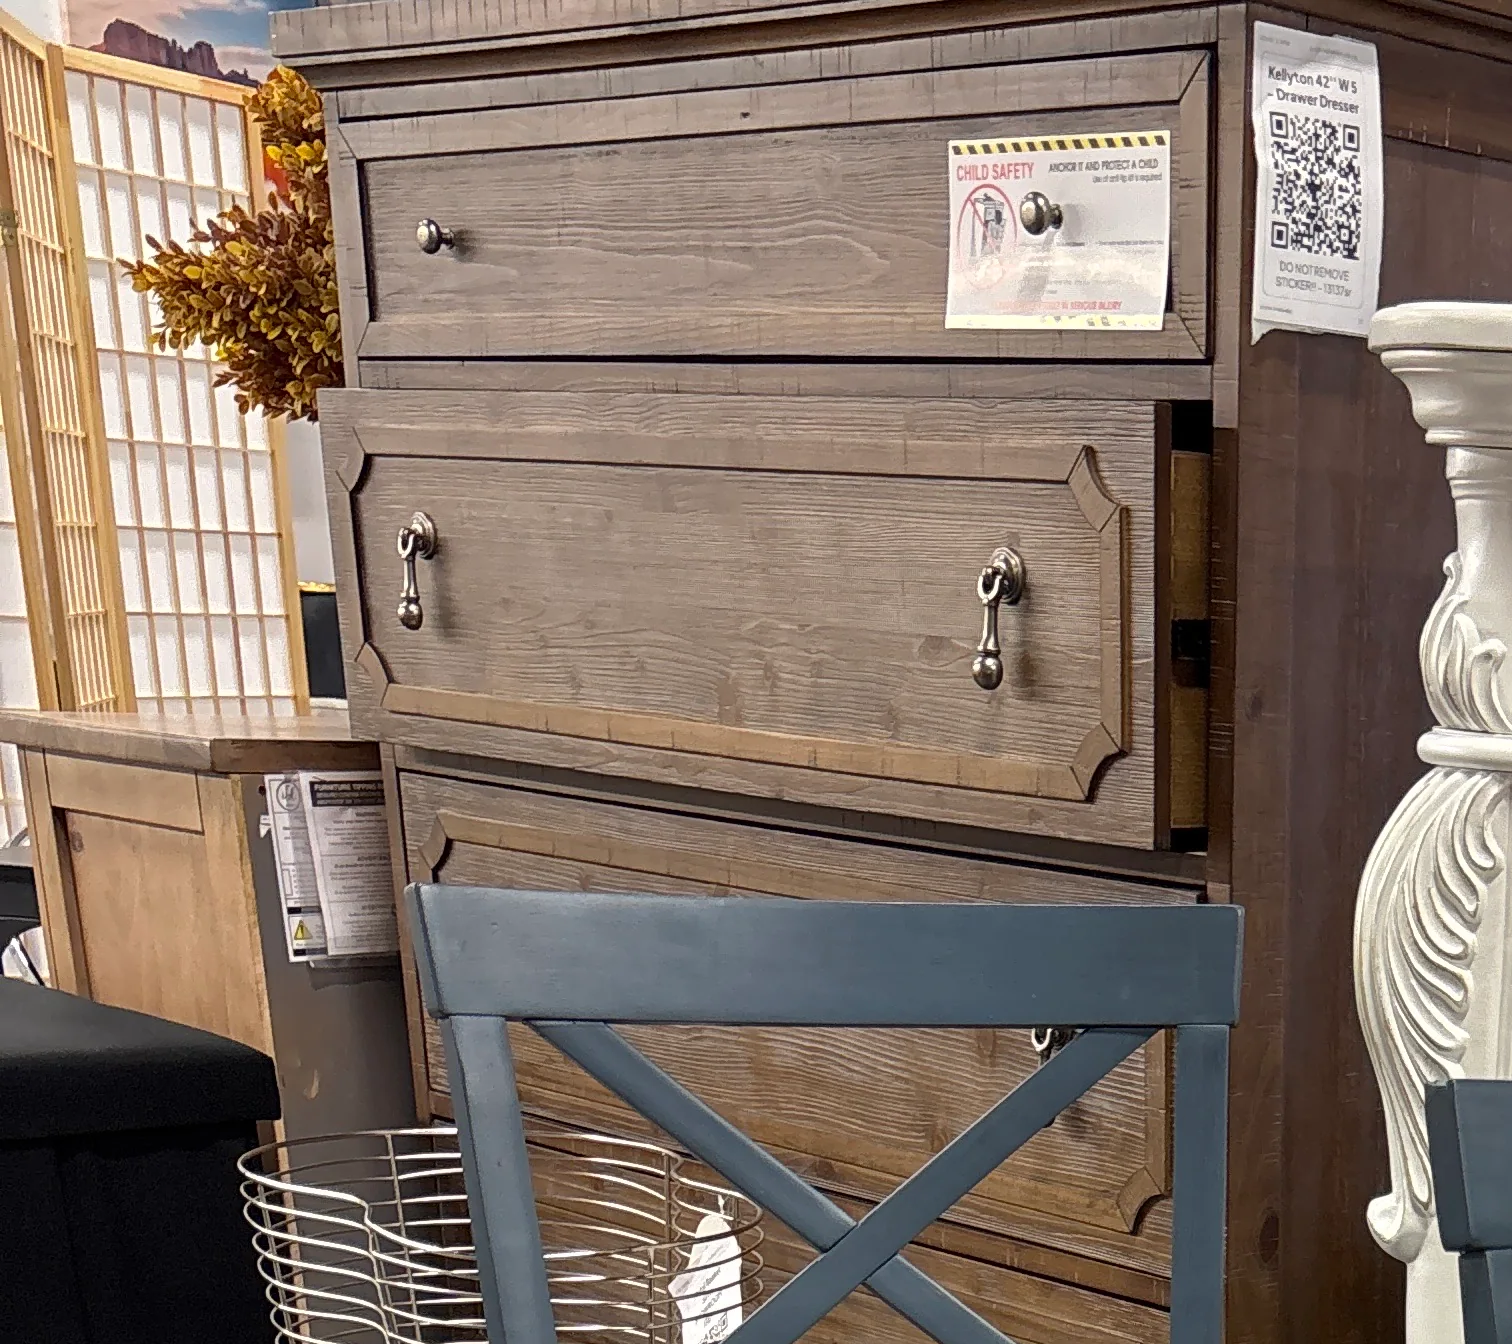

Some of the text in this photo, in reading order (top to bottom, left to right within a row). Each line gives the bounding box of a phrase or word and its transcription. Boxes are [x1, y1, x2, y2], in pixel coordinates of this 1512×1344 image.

[1268, 66, 1314, 86] Kellyton
[1338, 79, 1349, 92] W
[1352, 81, 1357, 94] 5
[1276, 88, 1359, 114] Drawer Dresser
[957, 163, 1034, 181] CHILD SAFETY
[1049, 163, 1076, 173] ANCHOR
[1085, 161, 1100, 171] AND
[1102, 160, 1129, 171] PROTECT
[1131, 160, 1136, 169] A
[1139, 158, 1158, 169] CHILD
[1280, 260, 1349, 282] DO NOT REMOVE
